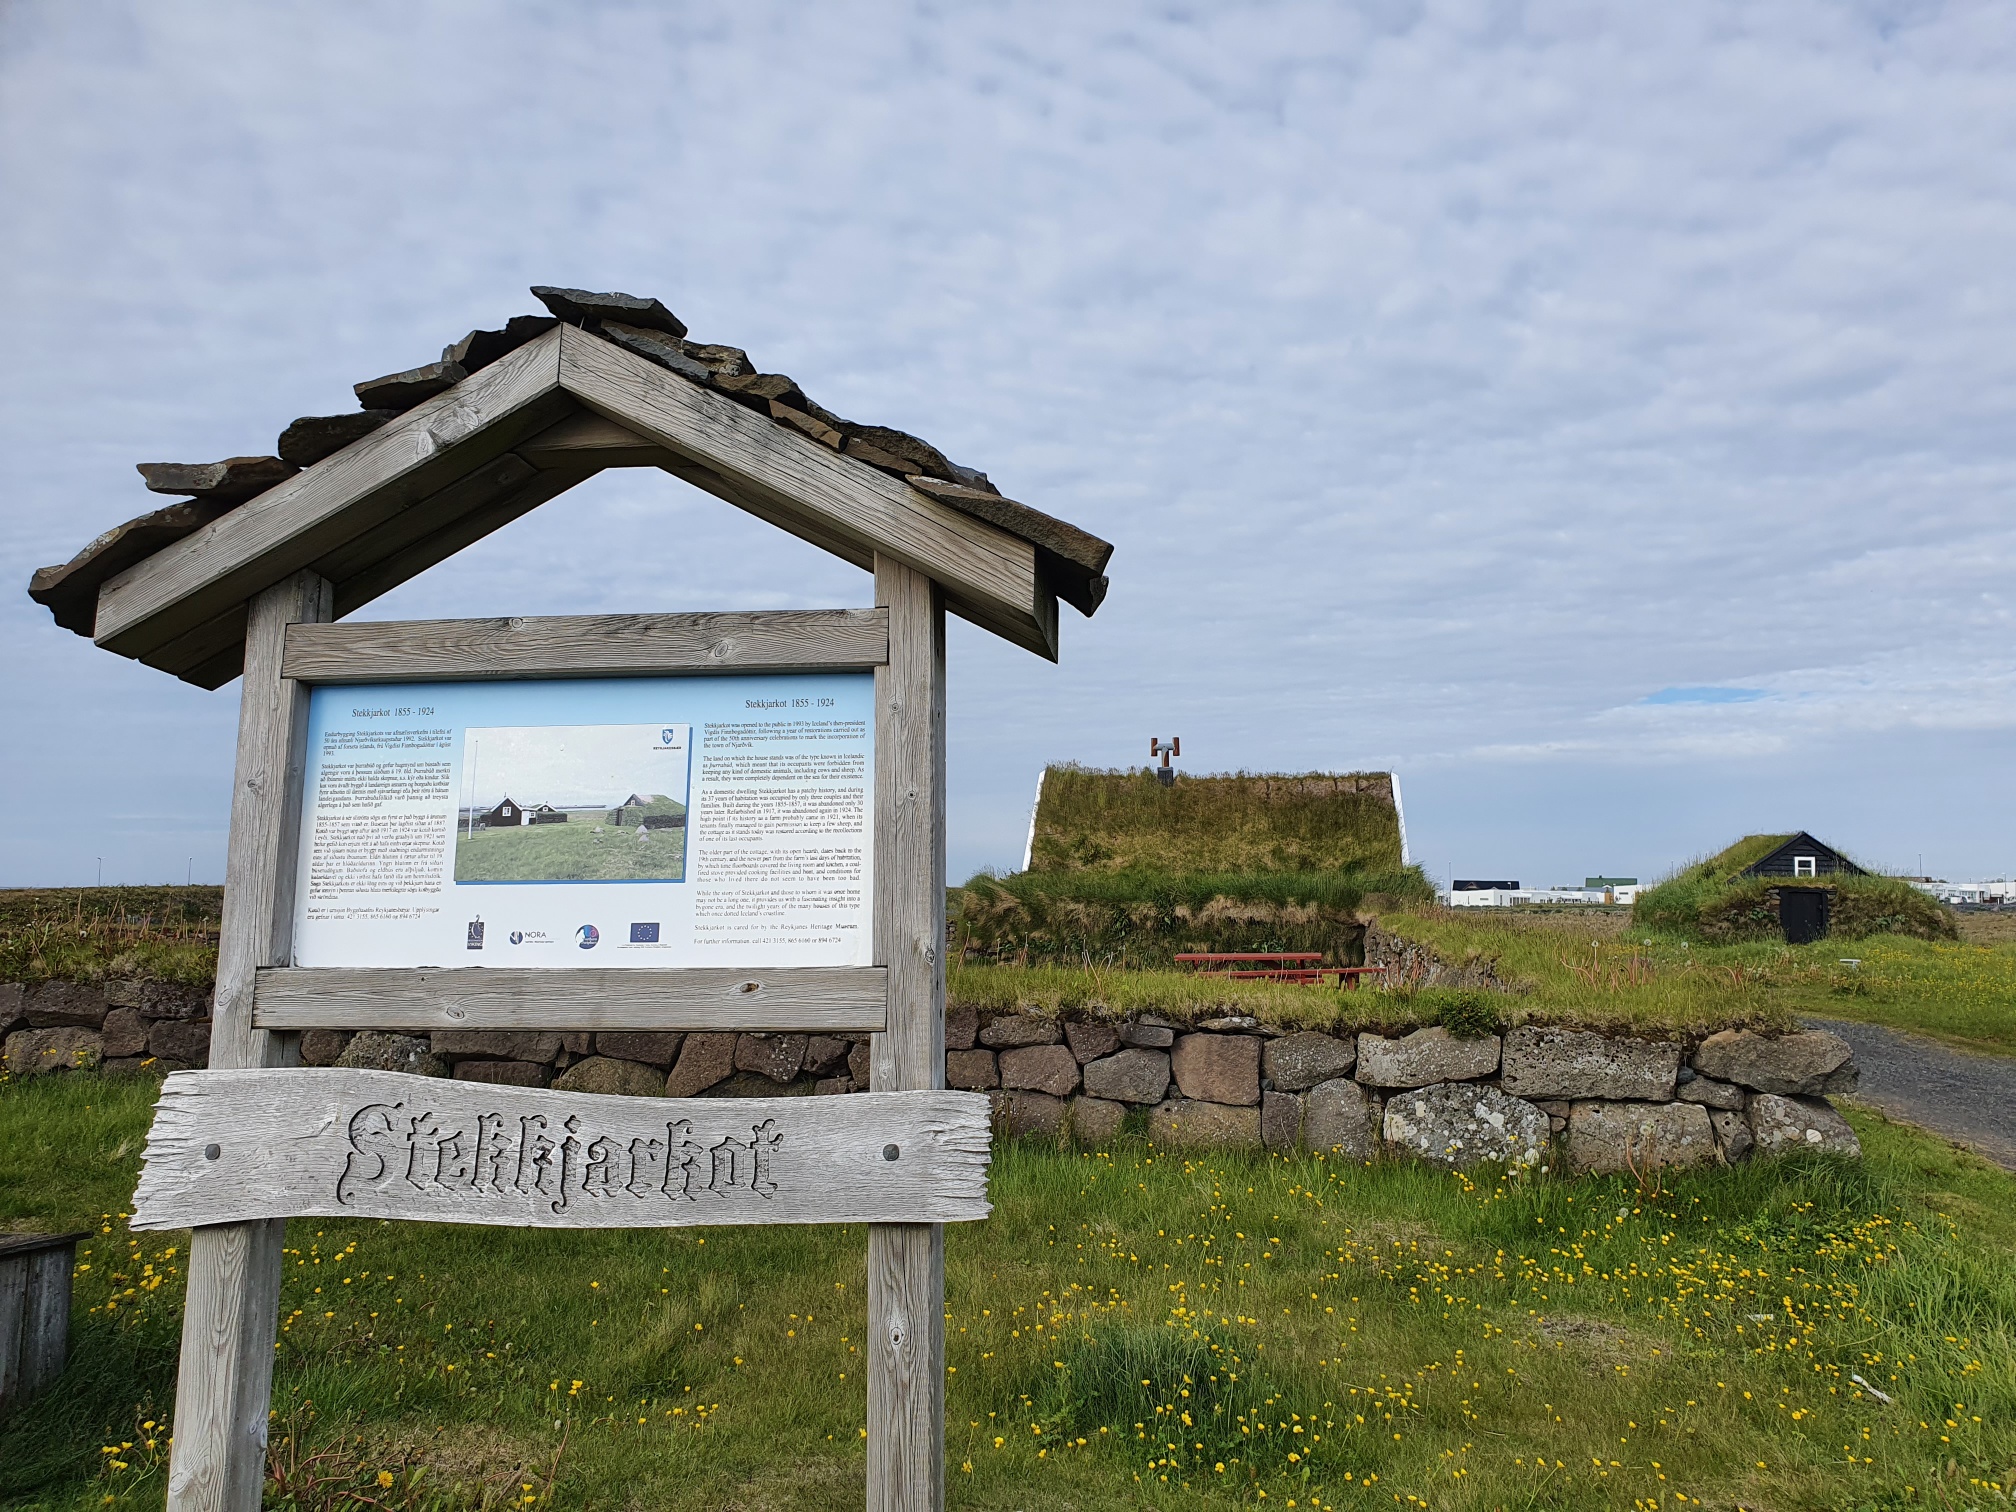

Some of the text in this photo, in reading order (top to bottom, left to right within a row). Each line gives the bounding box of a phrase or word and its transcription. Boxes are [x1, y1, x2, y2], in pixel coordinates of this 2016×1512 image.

[746, 698, 787, 710] Stekkjarkot
[792, 698, 809, 707] 1855
[817, 698, 834, 707] 1924
[352, 708, 390, 718] Stekkjarkot
[395, 708, 411, 716] 1855
[418, 707, 434, 715] 1924
[336, 1102, 784, 1214] Stekkjarkot
